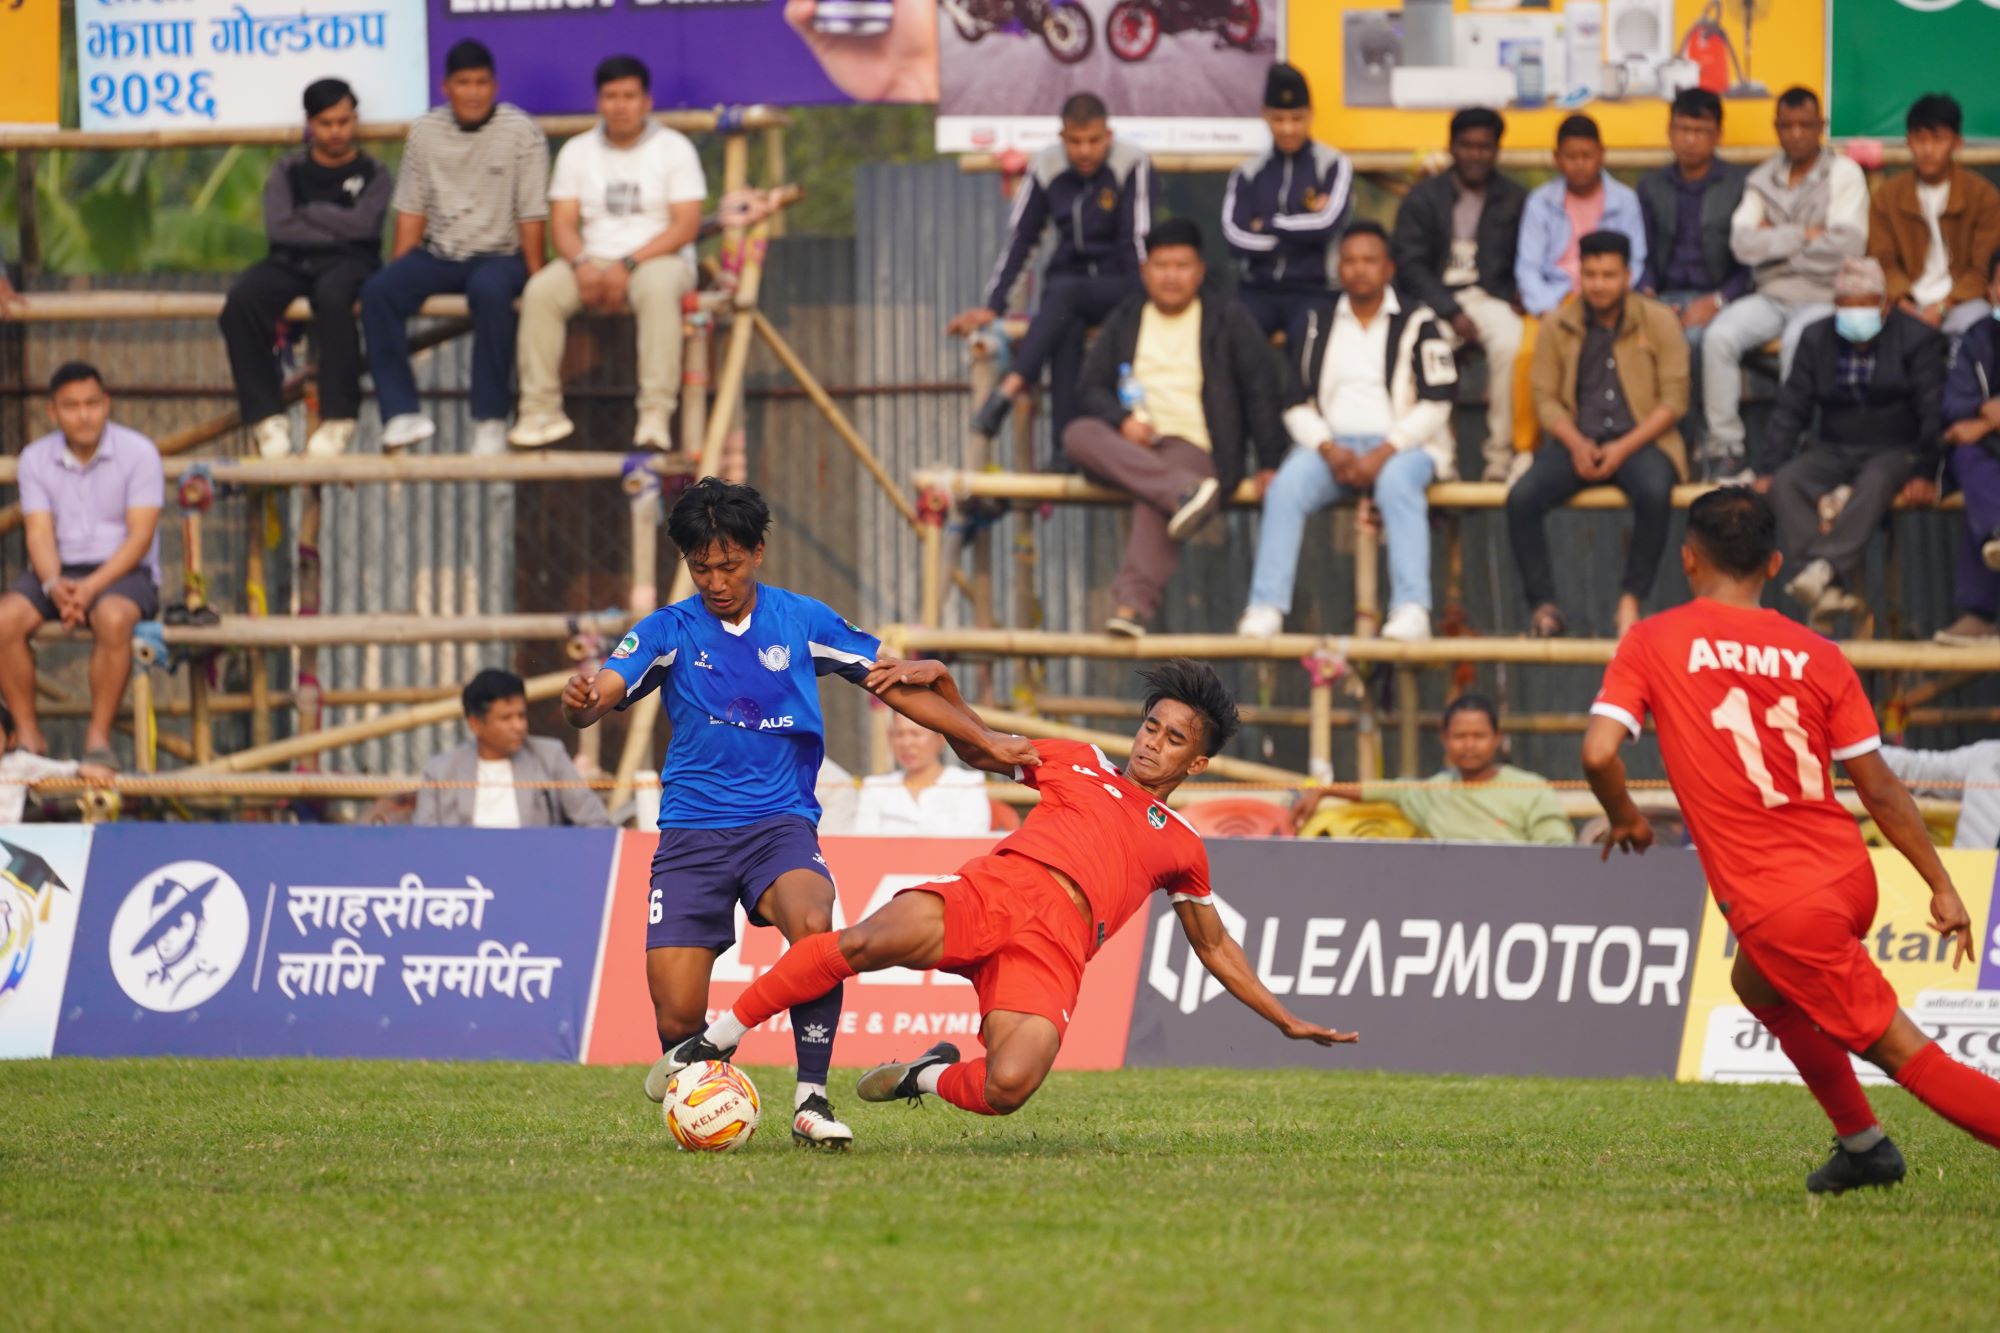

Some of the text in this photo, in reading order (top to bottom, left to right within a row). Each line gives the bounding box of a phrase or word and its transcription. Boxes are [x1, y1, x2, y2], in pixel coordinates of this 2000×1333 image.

[87, 20, 195, 58] झापा
[90, 69, 216, 118] २०२६
[1687, 637, 1810, 680] ARMY
[758, 715, 794, 730] AUS
[1710, 686, 1825, 809] 11
[287, 872, 495, 938] साहसीको
[649, 888, 664, 925] 6
[276, 937, 563, 1006] लागि समर्पित
[1256, 915, 1690, 1006] LEAPMOTOR
[691, 1101, 733, 1130] KELME
